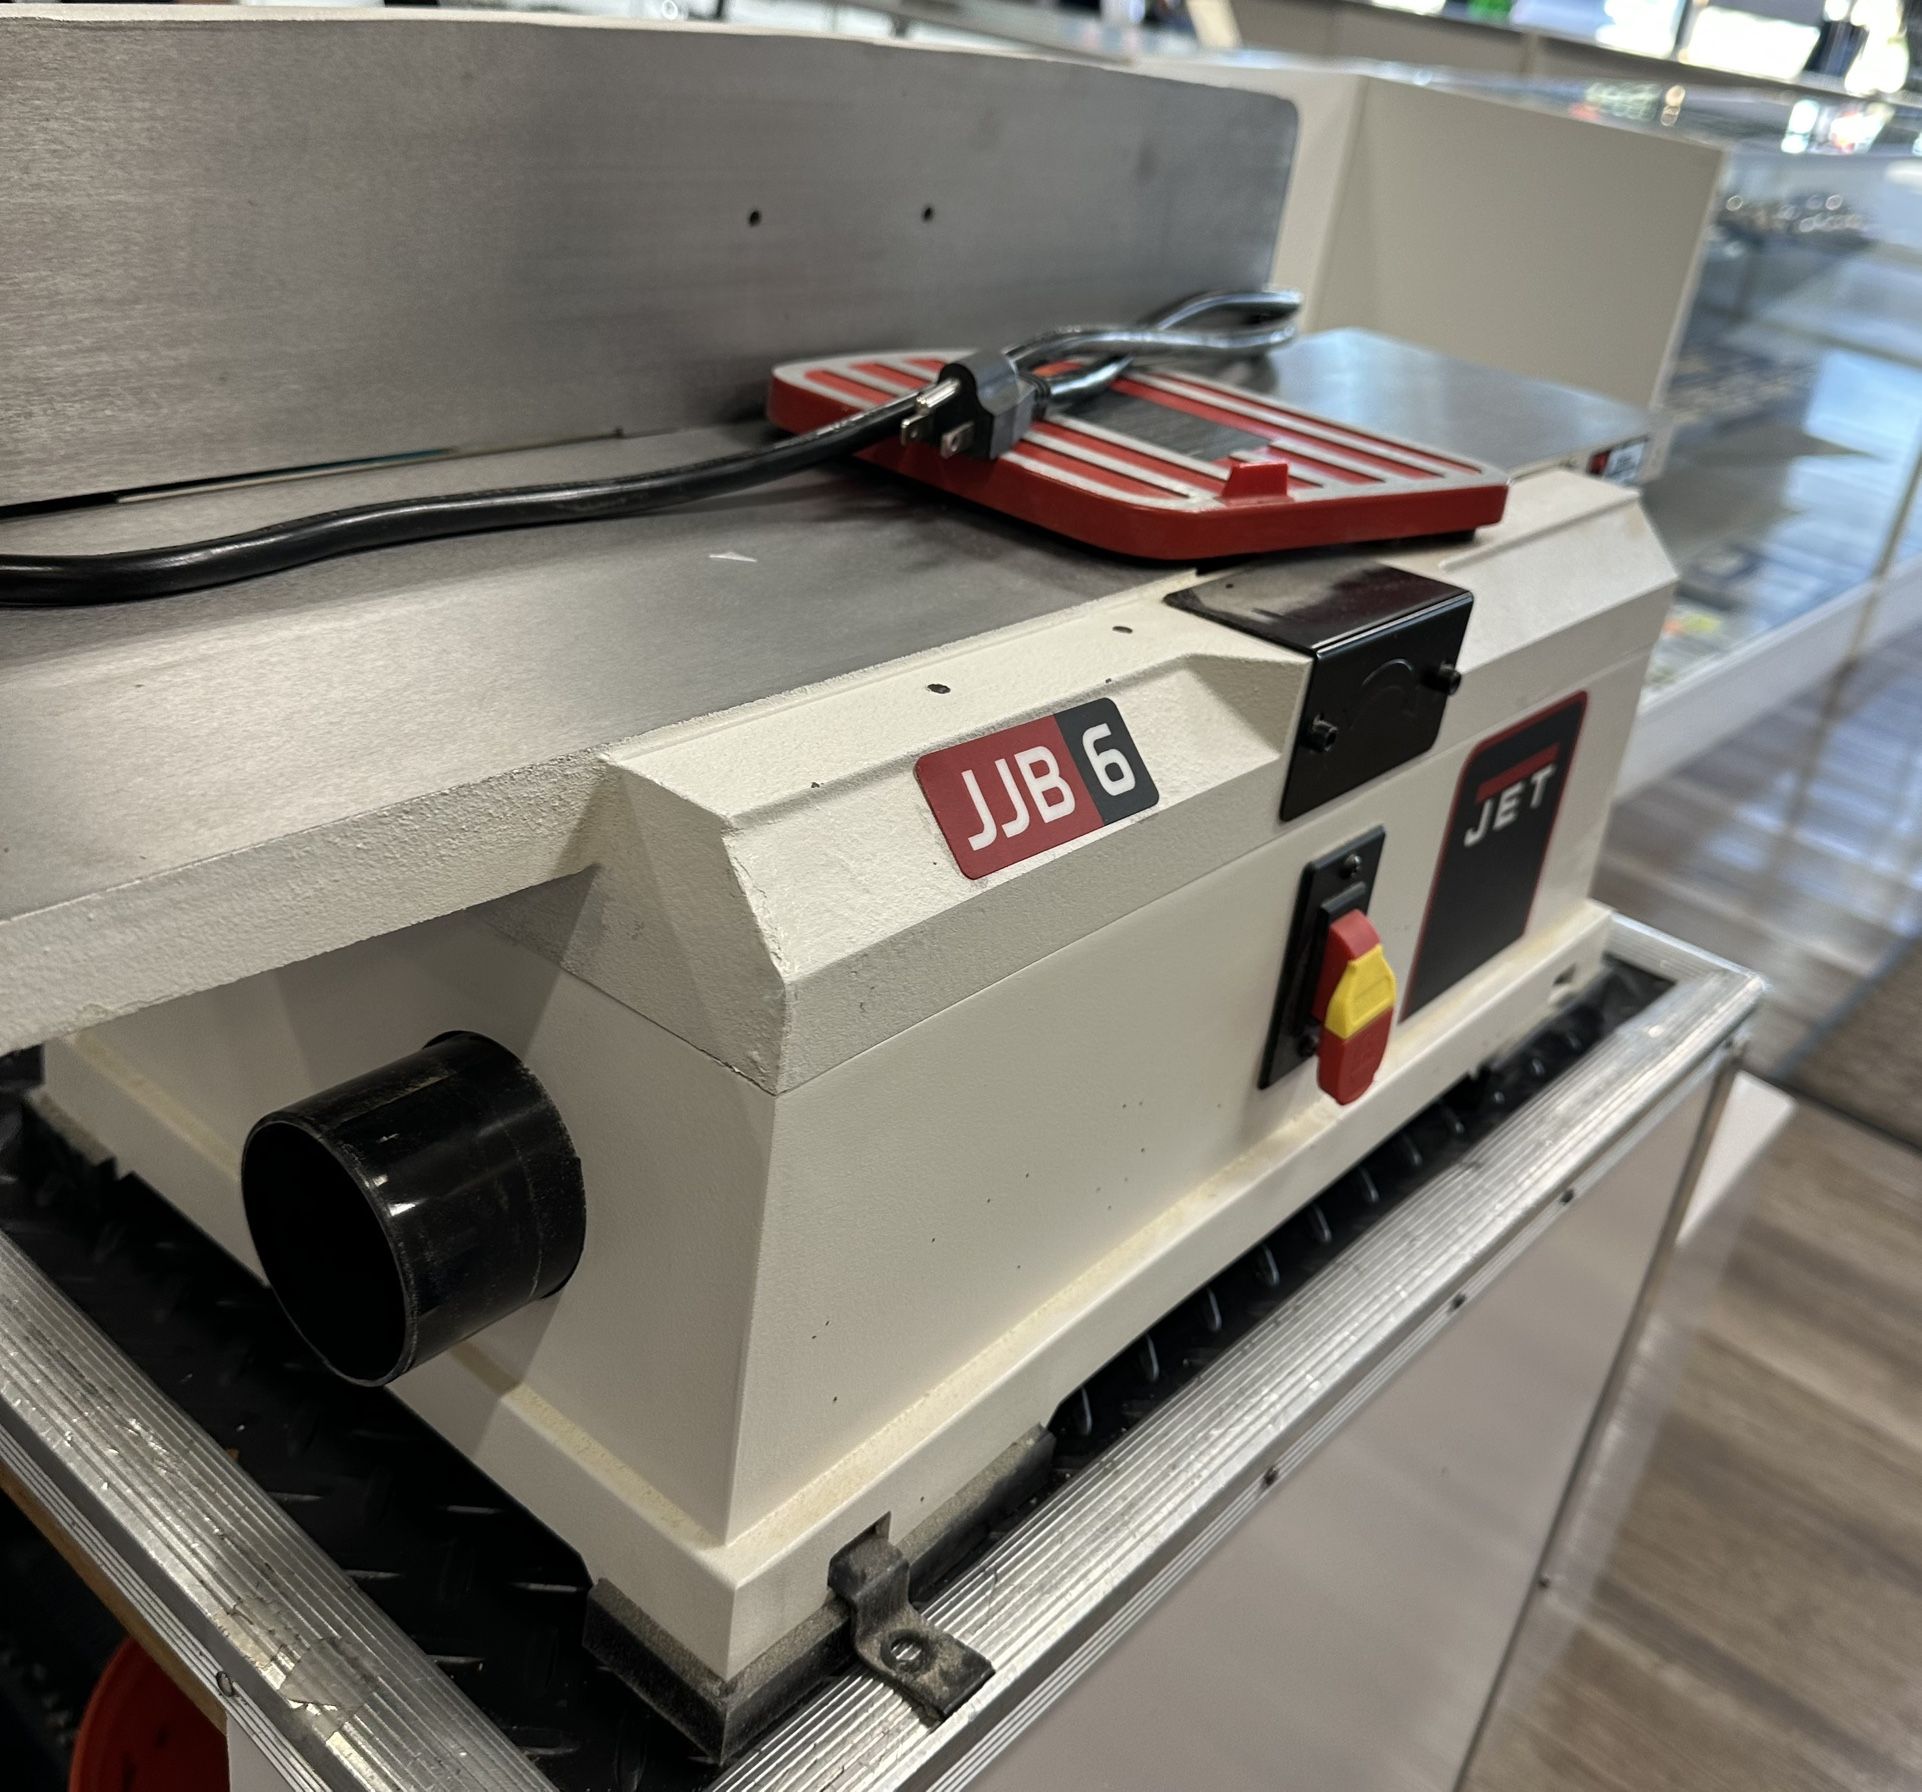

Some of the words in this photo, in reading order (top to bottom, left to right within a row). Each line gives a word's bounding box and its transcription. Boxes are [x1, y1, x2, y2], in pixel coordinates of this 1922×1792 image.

[961, 746, 1075, 851] JJB
[1082, 723, 1136, 797] 6
[1463, 764, 1557, 847] JET
